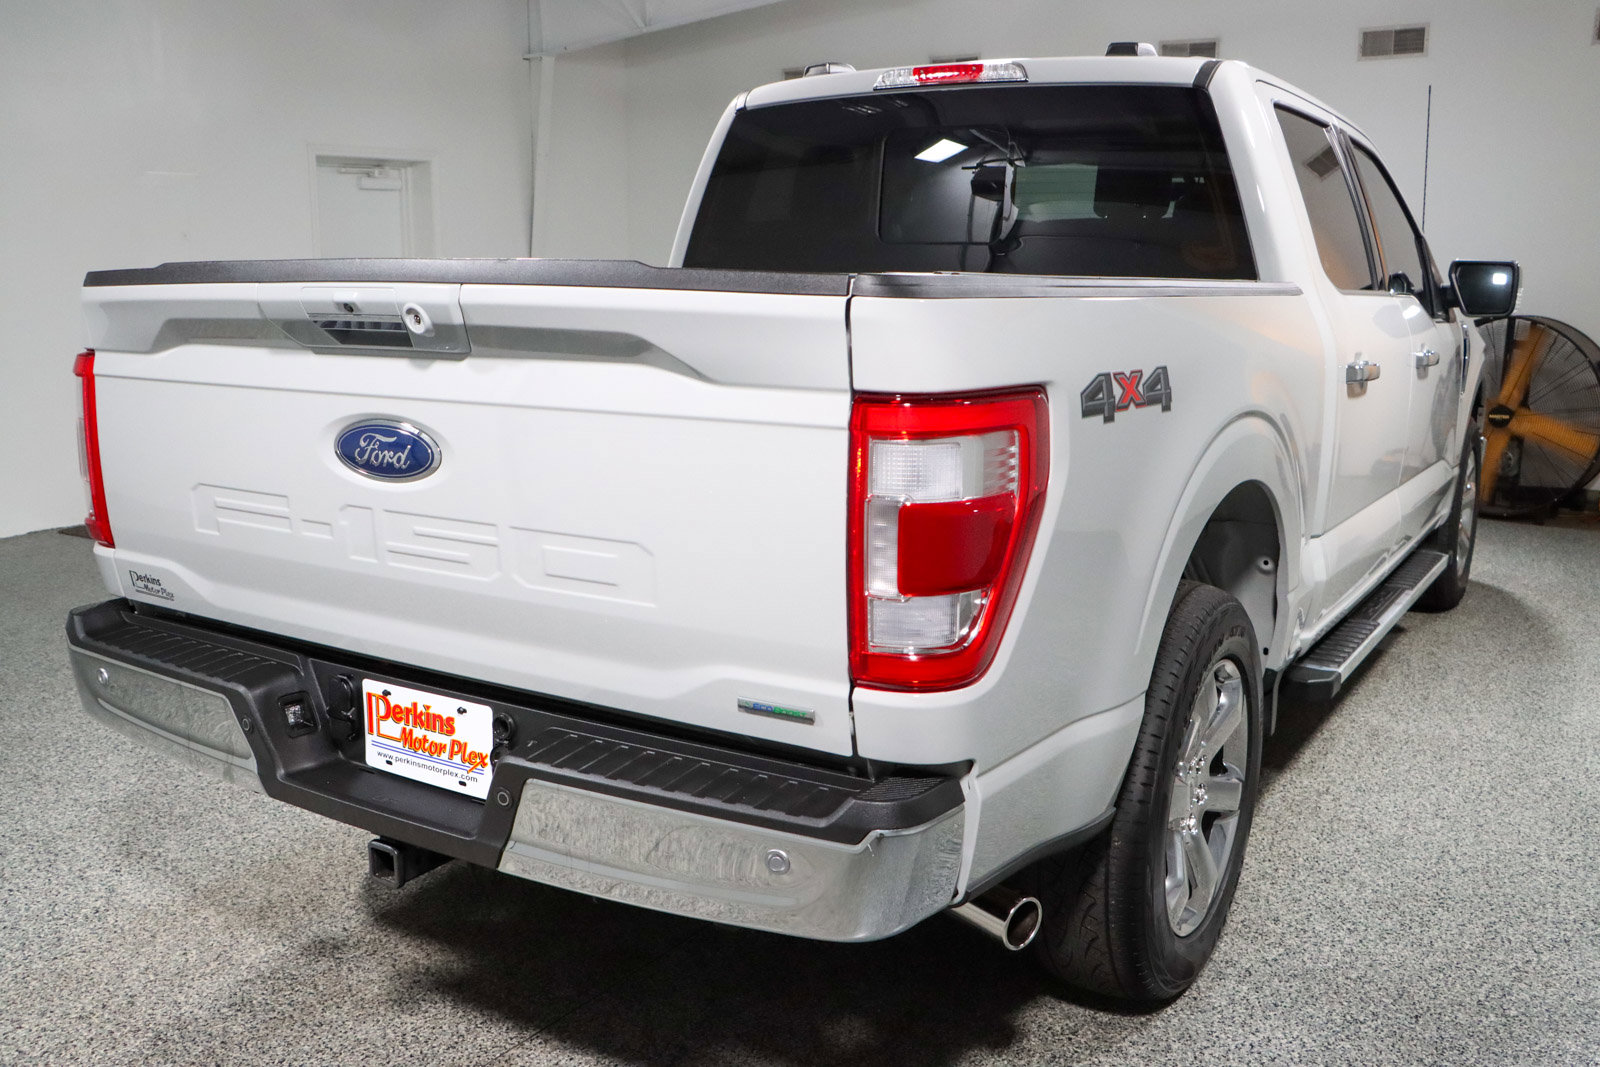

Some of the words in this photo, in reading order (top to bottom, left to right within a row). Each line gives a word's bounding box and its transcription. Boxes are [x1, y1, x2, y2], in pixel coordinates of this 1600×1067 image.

[355, 433, 411, 469] Ford
[191, 483, 657, 607] F-150
[129, 570, 161, 586] Perkins
[366, 691, 456, 737] Perkins
[377, 750, 478, 783] www.perkinsmotorplex.com
[400, 727, 447, 757] Motor
[448, 739, 488, 774] Plex
